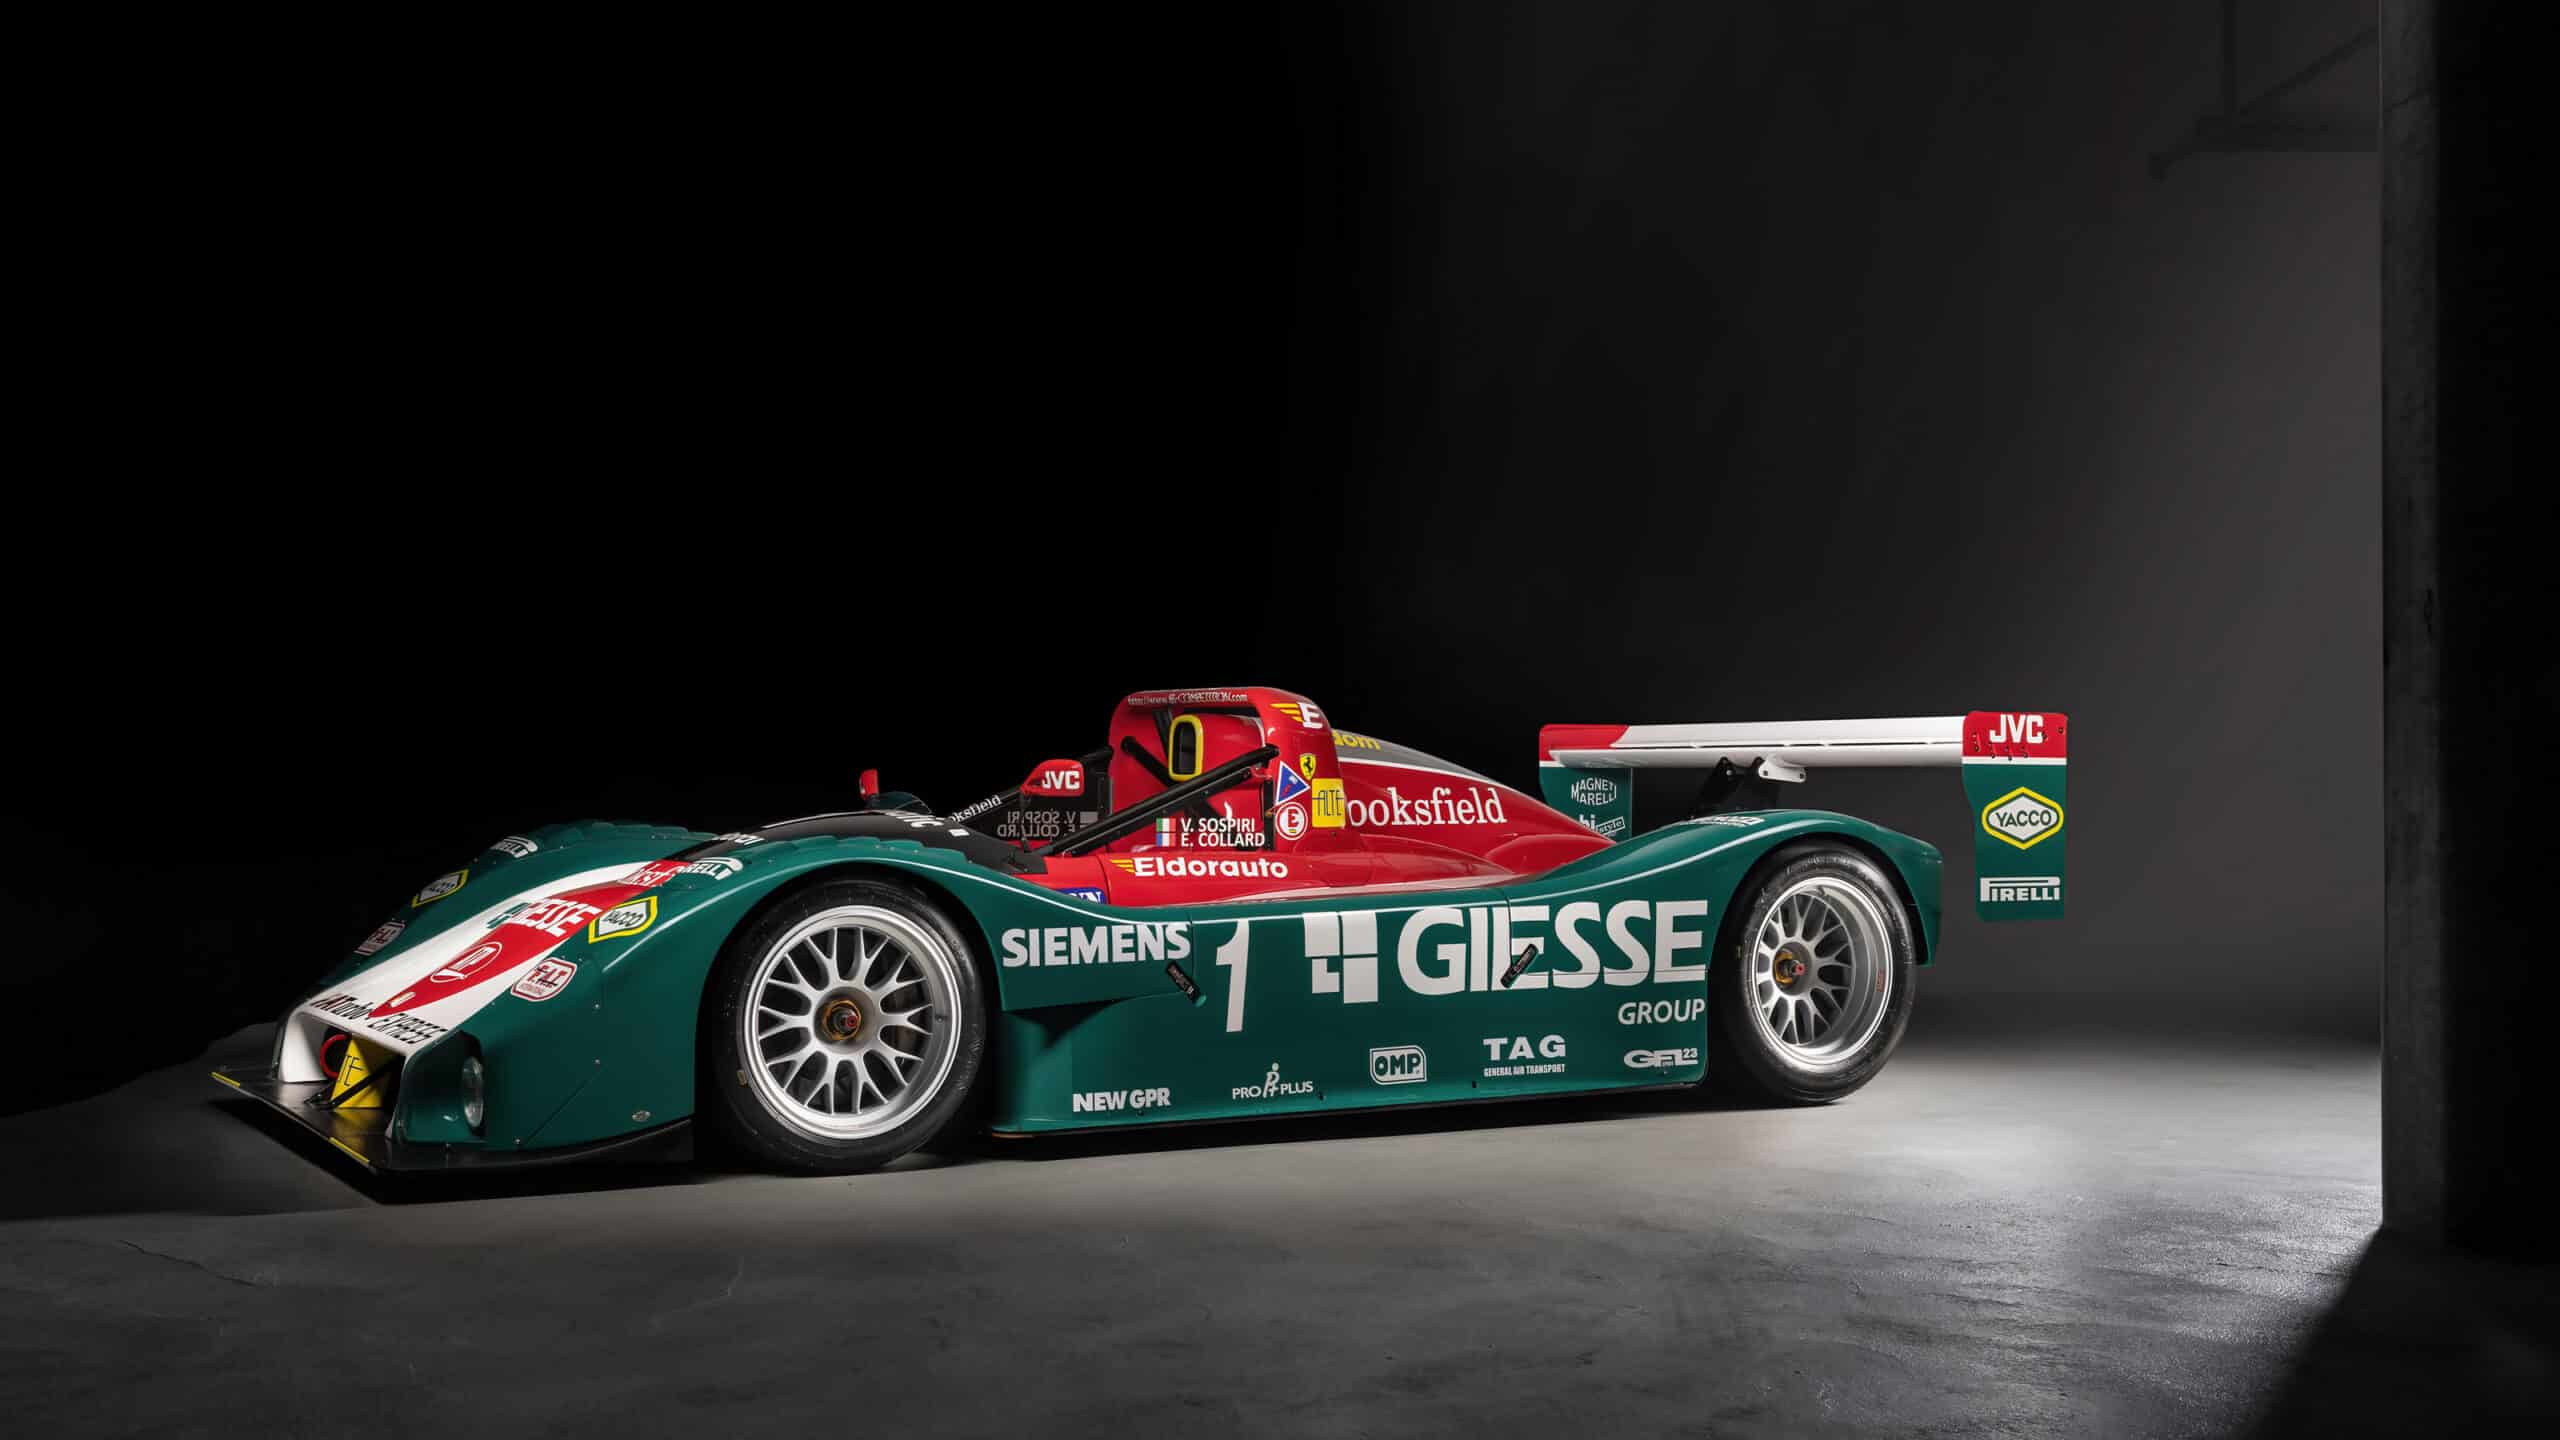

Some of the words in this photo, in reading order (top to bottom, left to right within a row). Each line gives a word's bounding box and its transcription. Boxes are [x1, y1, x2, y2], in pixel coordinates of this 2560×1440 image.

[1989, 714, 2044, 743] JVC
[1042, 770, 1080, 790] JVC
[1571, 777, 1616, 796] MAGNETI
[1571, 788, 1616, 806] MARELLI
[1180, 818, 1194, 833] V.
[1198, 818, 1255, 833] SOSPIRI
[1995, 809, 2052, 828] YACCO
[1180, 832, 1194, 847] E.
[1198, 832, 1266, 847] COLLARD
[1134, 857, 1289, 879] Eldorauto
[1980, 876, 2060, 902] PIRELLI
[1002, 922, 1193, 968] SIEMENS
[1397, 900, 1708, 996] GIESSE
[1216, 919, 1249, 1033] 1
[1618, 998, 1706, 1025] GROUP
[1482, 1034, 1567, 1061] TAG
[1374, 1052, 1421, 1077] OMP
[1483, 1066, 1513, 1078] GENERAL
[1525, 1063, 1566, 1075] TRANSPORT
[1072, 1091, 1128, 1113] NEW
[1129, 1087, 1171, 1110] GPR
[1231, 1085, 1262, 1101] PRO
[1279, 1080, 1314, 1096] PLUS
